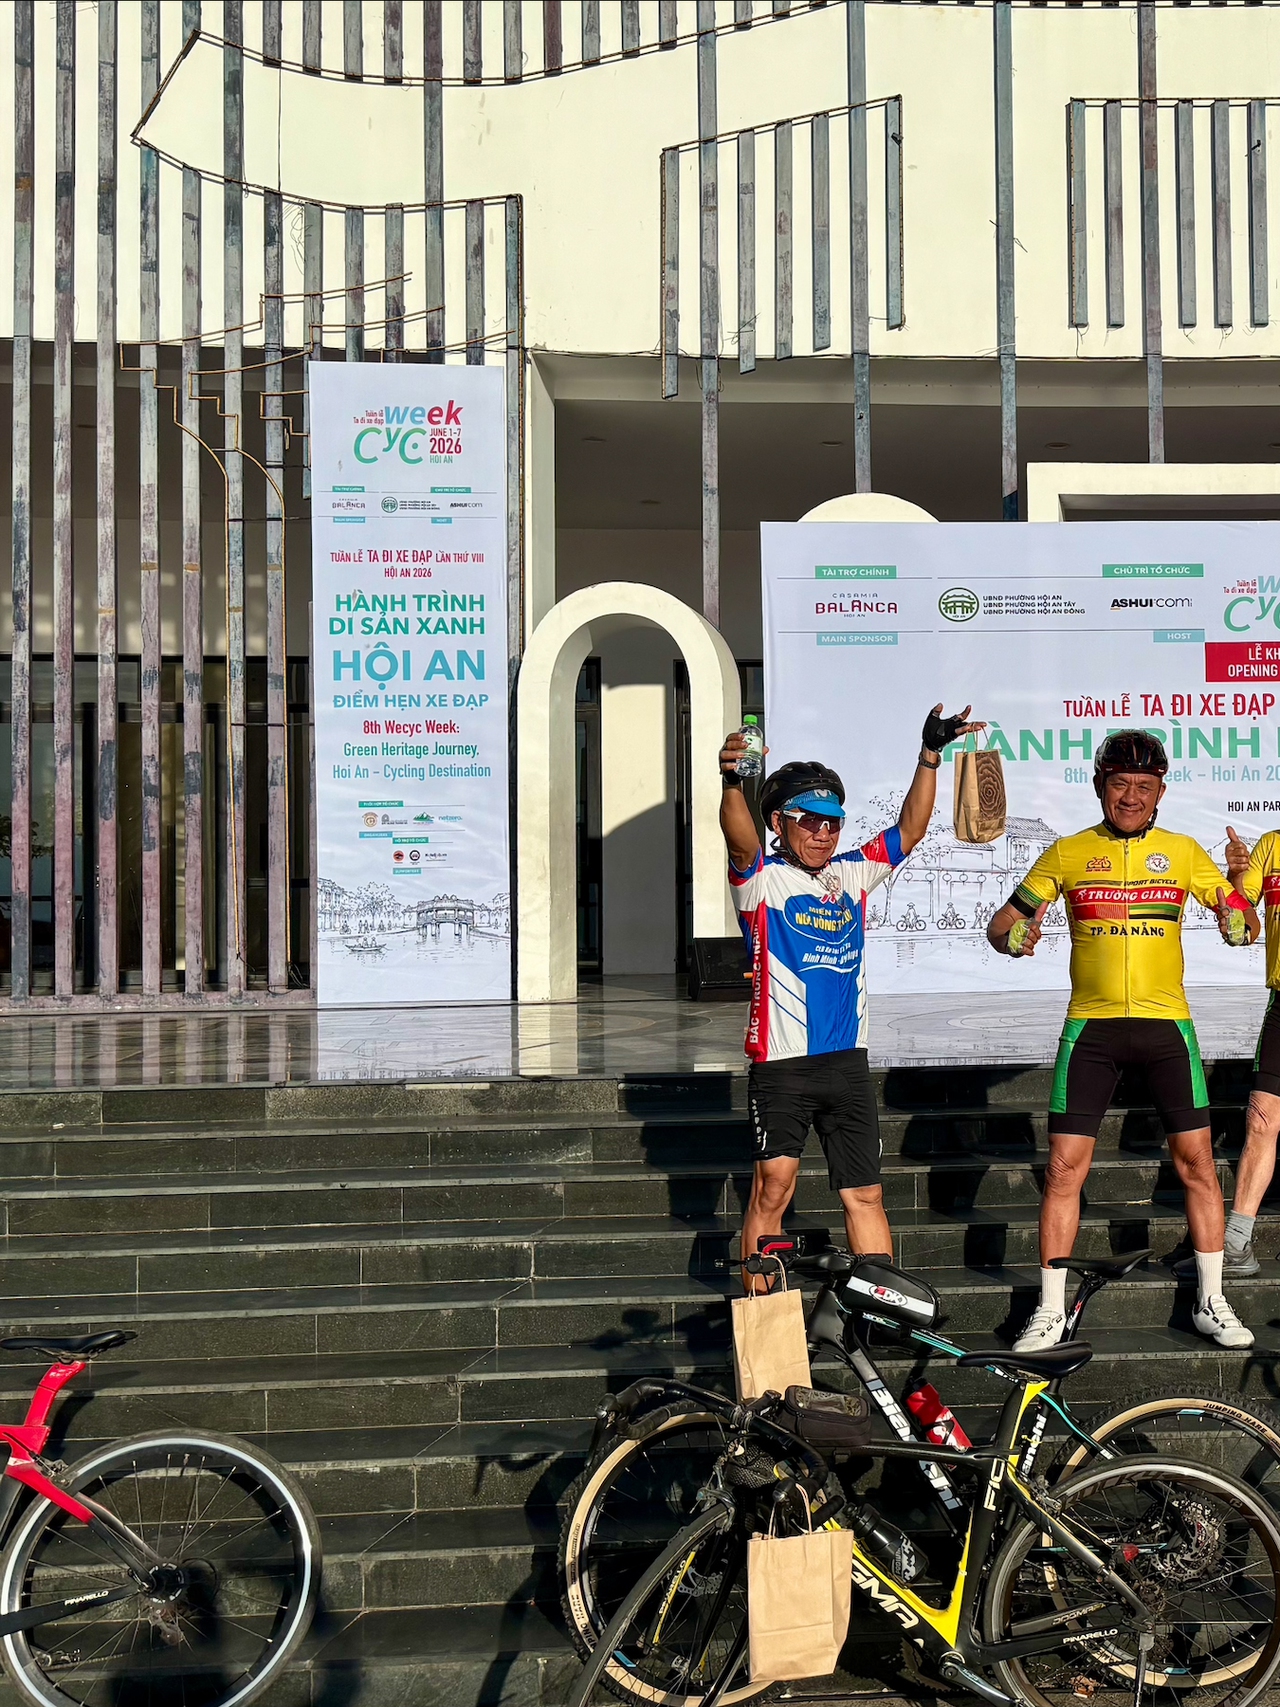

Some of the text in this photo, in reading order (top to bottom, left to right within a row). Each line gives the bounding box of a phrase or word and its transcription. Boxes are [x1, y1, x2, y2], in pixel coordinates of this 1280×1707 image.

[384, 400, 463, 425] week
[429, 428, 447, 436] JUNE
[429, 437, 461, 455] 2026
[367, 550, 379, 562] TA
[382, 550, 393, 562] ĐI
[396, 550, 409, 562] XE
[411, 550, 432, 565] ĐẠP
[471, 553, 484, 562] VIII
[384, 565, 432, 579] HỘI AN 2026
[335, 589, 485, 612] HÀNH TRÌNH
[329, 612, 485, 635] DI SẢN XANH
[1248, 643, 1263, 660] LỄ
[333, 641, 485, 690] HỘI AN
[1228, 664, 1278, 677] OPENING
[332, 689, 489, 711] ĐIỂM HẸN XE ĐẠP
[1063, 695, 1106, 717] TUẦN
[1112, 692, 1131, 716] LỄ
[1140, 694, 1164, 716] TA
[1171, 694, 1192, 716] ĐI
[1199, 693, 1226, 715] XE
[1232, 693, 1275, 720] ĐẠP
[363, 719, 460, 738] 8th Wecyc Week:
[343, 743, 378, 757] Green
[381, 742, 429, 760] Heritage
[333, 763, 491, 781] Hoi An Cycling Destination
[1064, 767, 1088, 784] 8th
[1212, 766, 1260, 782] Hoi An
[1227, 801, 1244, 812] HOI
[1247, 801, 1262, 811] AN
[1088, 889, 1177, 901] TRƯỜNG GIANG
[1090, 927, 1106, 936] TP.
[1110, 924, 1128, 936] ĐÀ
[64, 1590, 109, 1606] PINARELLO
[1062, 1628, 1118, 1644] PINARELLO
